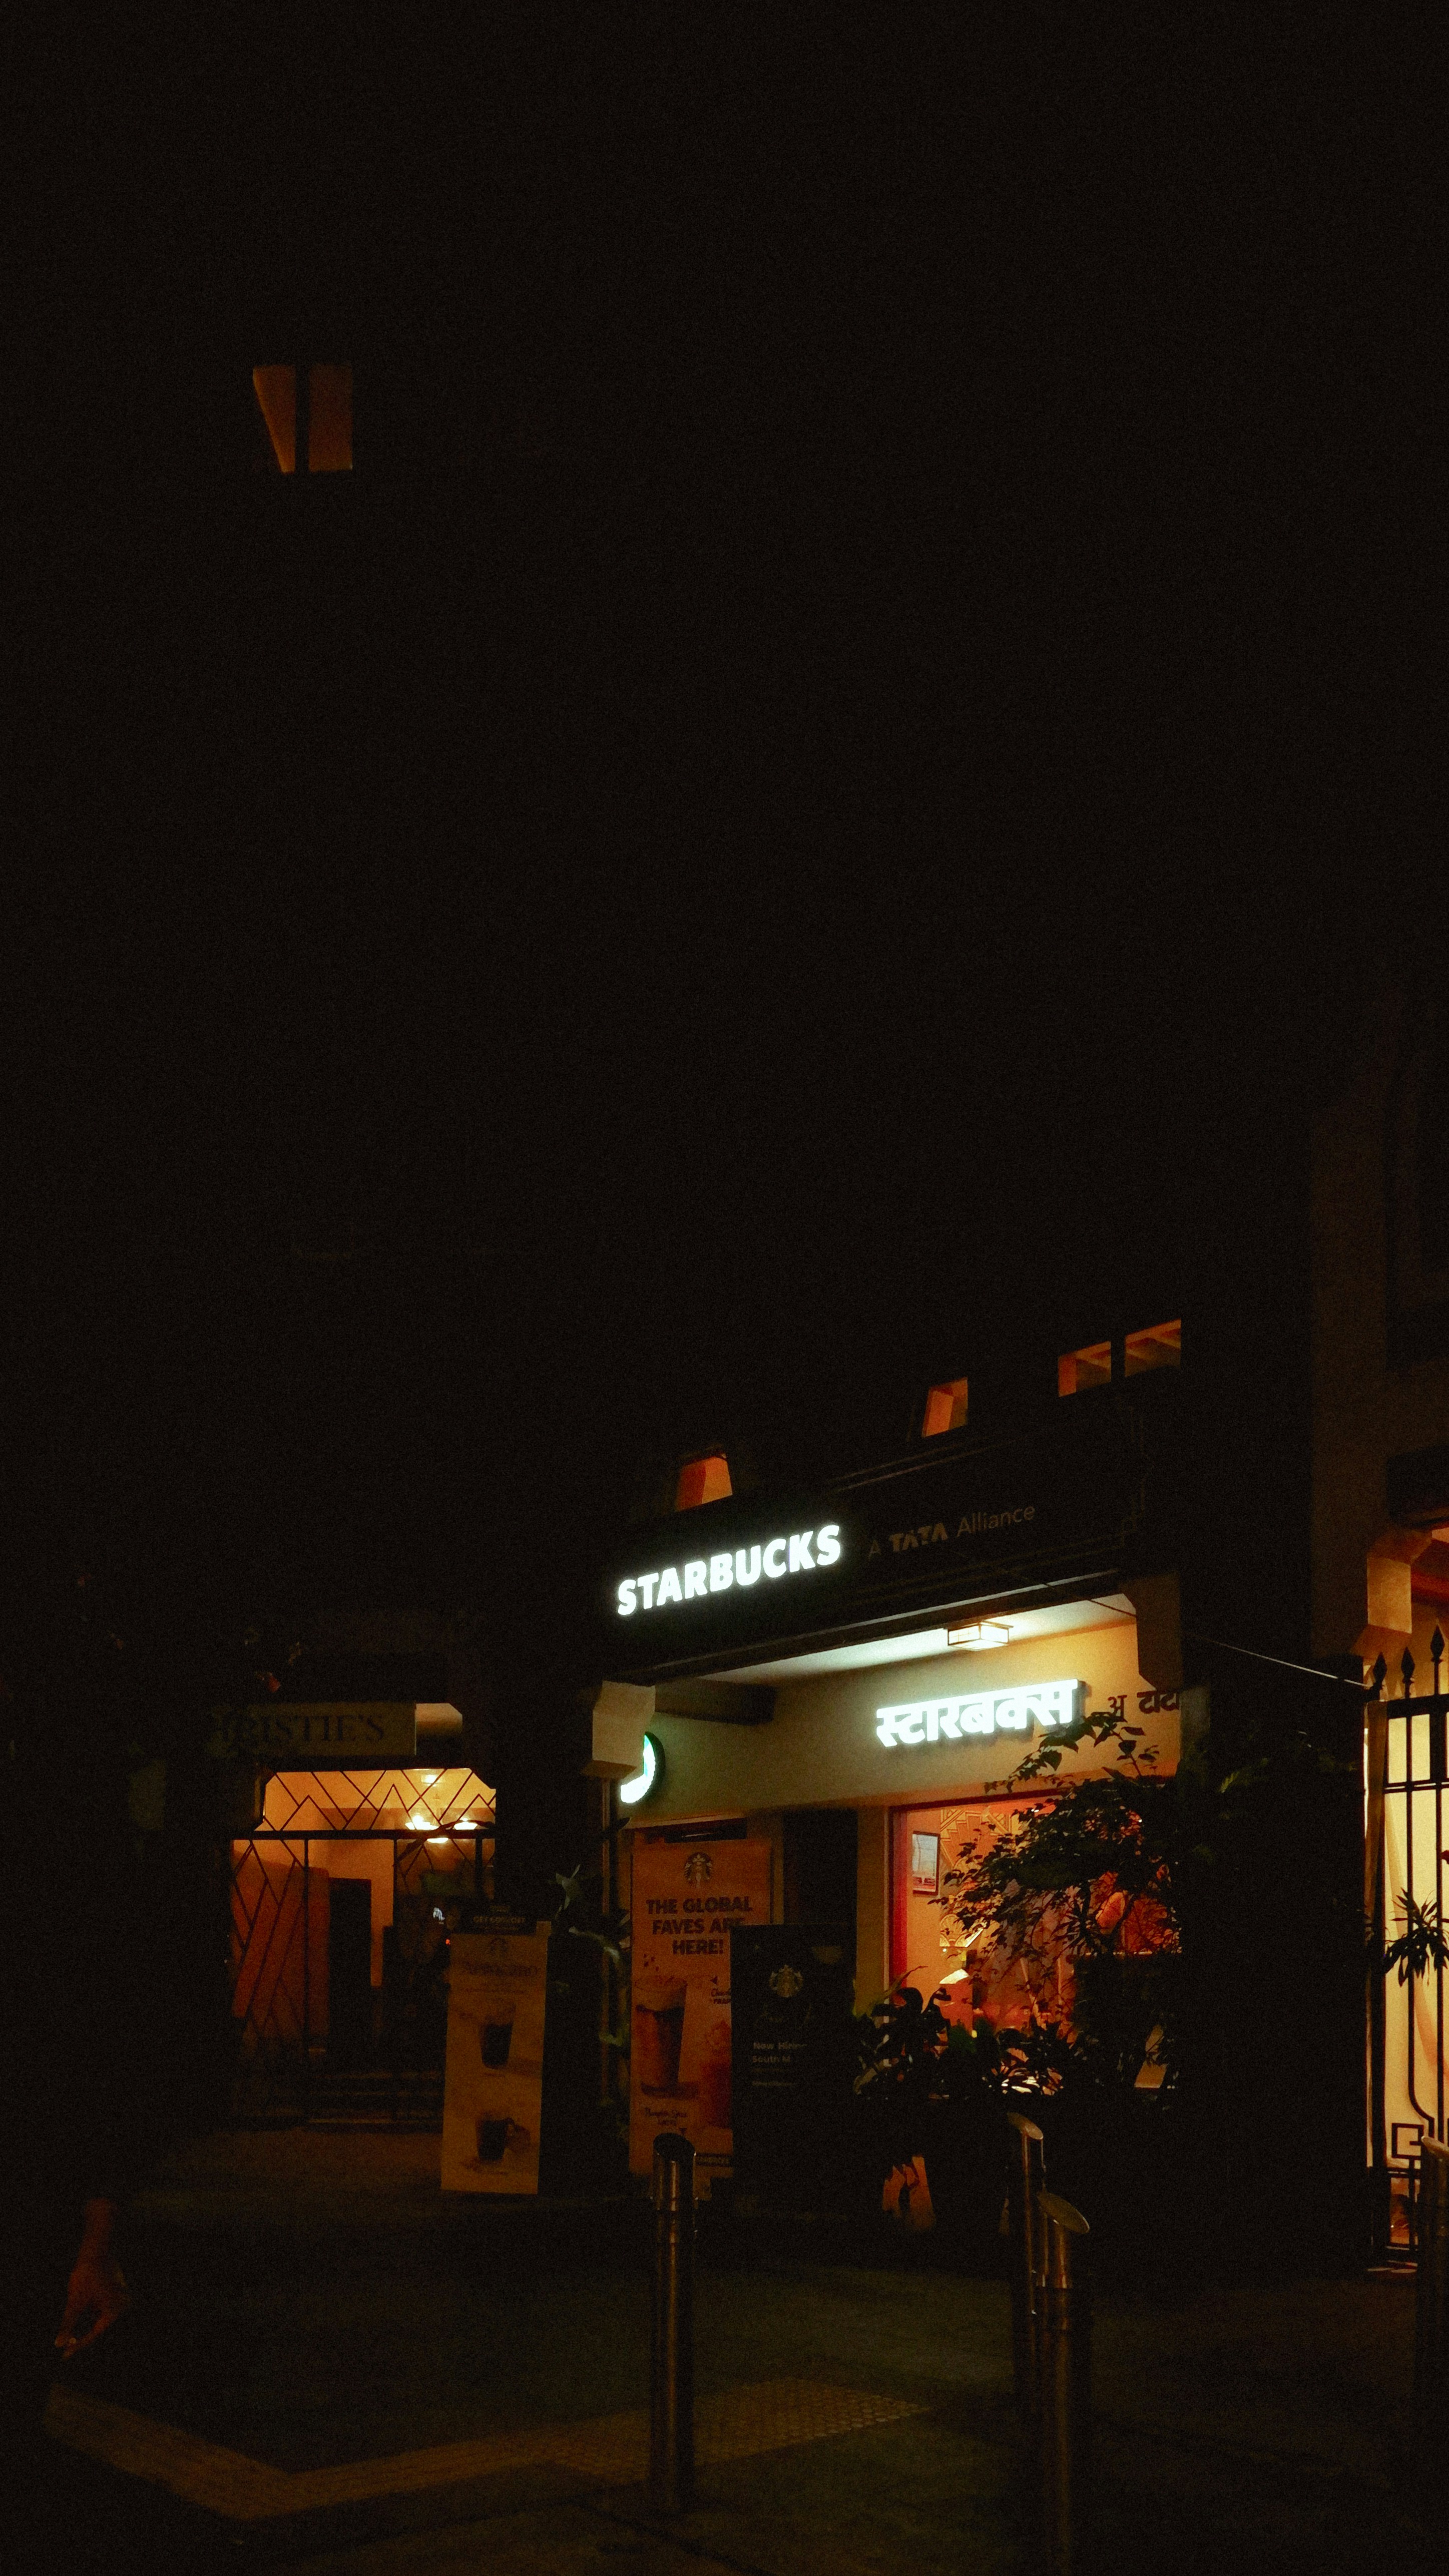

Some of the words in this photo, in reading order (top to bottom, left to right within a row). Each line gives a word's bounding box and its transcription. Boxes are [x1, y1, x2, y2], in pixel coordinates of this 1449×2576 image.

[868, 1539, 881, 1560] A
[888, 1522, 948, 1552] TATA
[956, 1506, 1035, 1538] Alliance
[618, 1525, 840, 1614] STARBUCKS
[877, 1679, 1076, 1746] स्टारबक्स
[647, 1899, 677, 1915] THE
[683, 1896, 752, 1914] GLOBAL
[652, 1918, 704, 1935] FAVES
[673, 1939, 724, 1955] HERE!
